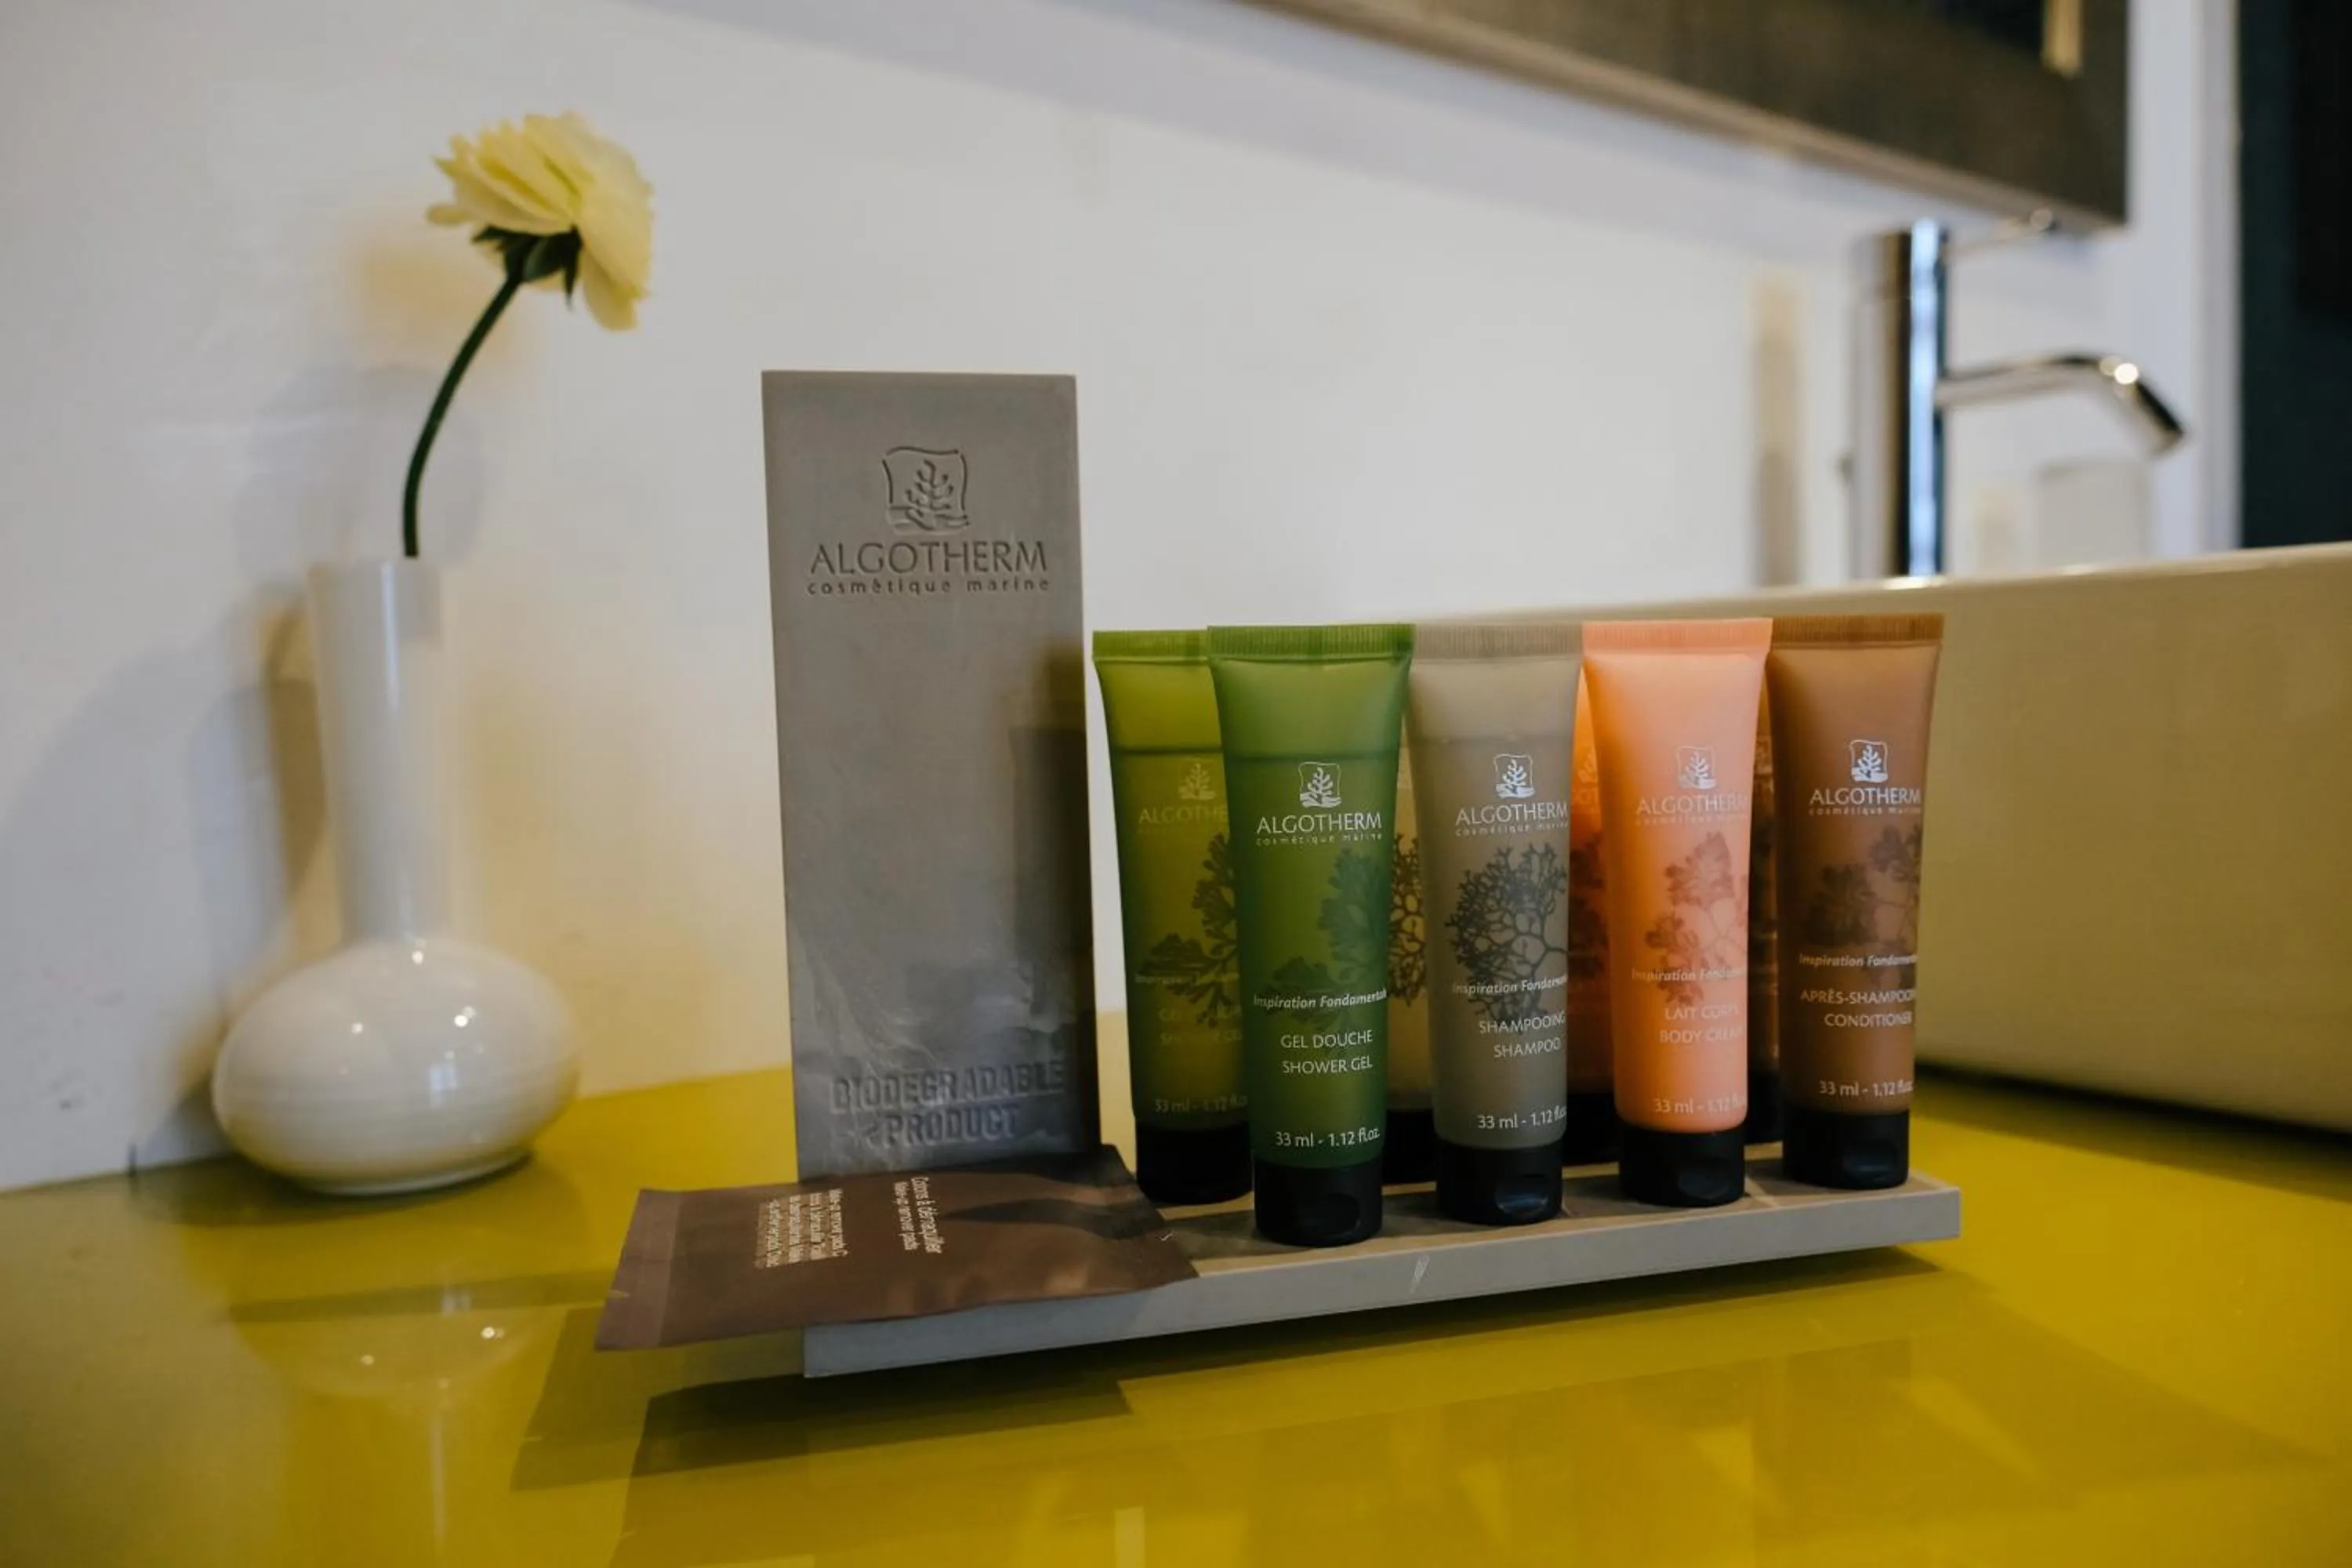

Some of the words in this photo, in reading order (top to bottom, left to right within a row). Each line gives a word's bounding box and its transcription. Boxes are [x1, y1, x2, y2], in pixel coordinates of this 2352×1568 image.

[810, 540, 1048, 575] ALGOTHERM
[967, 579, 1051, 593] marine
[1809, 787, 1921, 805] ALGOTHERM
[1138, 804, 1228, 825] ALGOTHE
[1256, 811, 1383, 835] ALGOTHERM
[1455, 801, 1568, 826] ALGOTHERM
[1798, 953, 1864, 968] Inspiration
[1632, 967, 1697, 983] Inspiration
[1452, 982, 1518, 997] Inspiration
[1254, 995, 1317, 1010] Inspiration
[1479, 1011, 1566, 1035] SHAMPOOING
[1664, 1006, 1697, 1021] LAIT
[1280, 1033, 1308, 1049] GEL
[1312, 1029, 1374, 1048] DOUCHE
[1659, 1029, 1703, 1044] BODY
[1494, 1036, 1561, 1058] SHAMPOO
[1282, 1058, 1348, 1075] SHOWER
[1350, 1054, 1374, 1072] GEL
[830, 1059, 1065, 1114] BIODEGRADABLE
[1819, 1080, 1836, 1096] 33
[1839, 1081, 1860, 1097] ml
[1653, 1098, 1671, 1113] 33
[1675, 1098, 1694, 1114] ml
[883, 1104, 1021, 1149] PRODUCT
[1476, 1114, 1495, 1130] 33
[1499, 1112, 1519, 1130] ml
[1530, 1109, 1553, 1127] 1.12
[1276, 1131, 1292, 1147] 33
[1295, 1132, 1314, 1148] ml
[1328, 1131, 1356, 1148] 1.12
